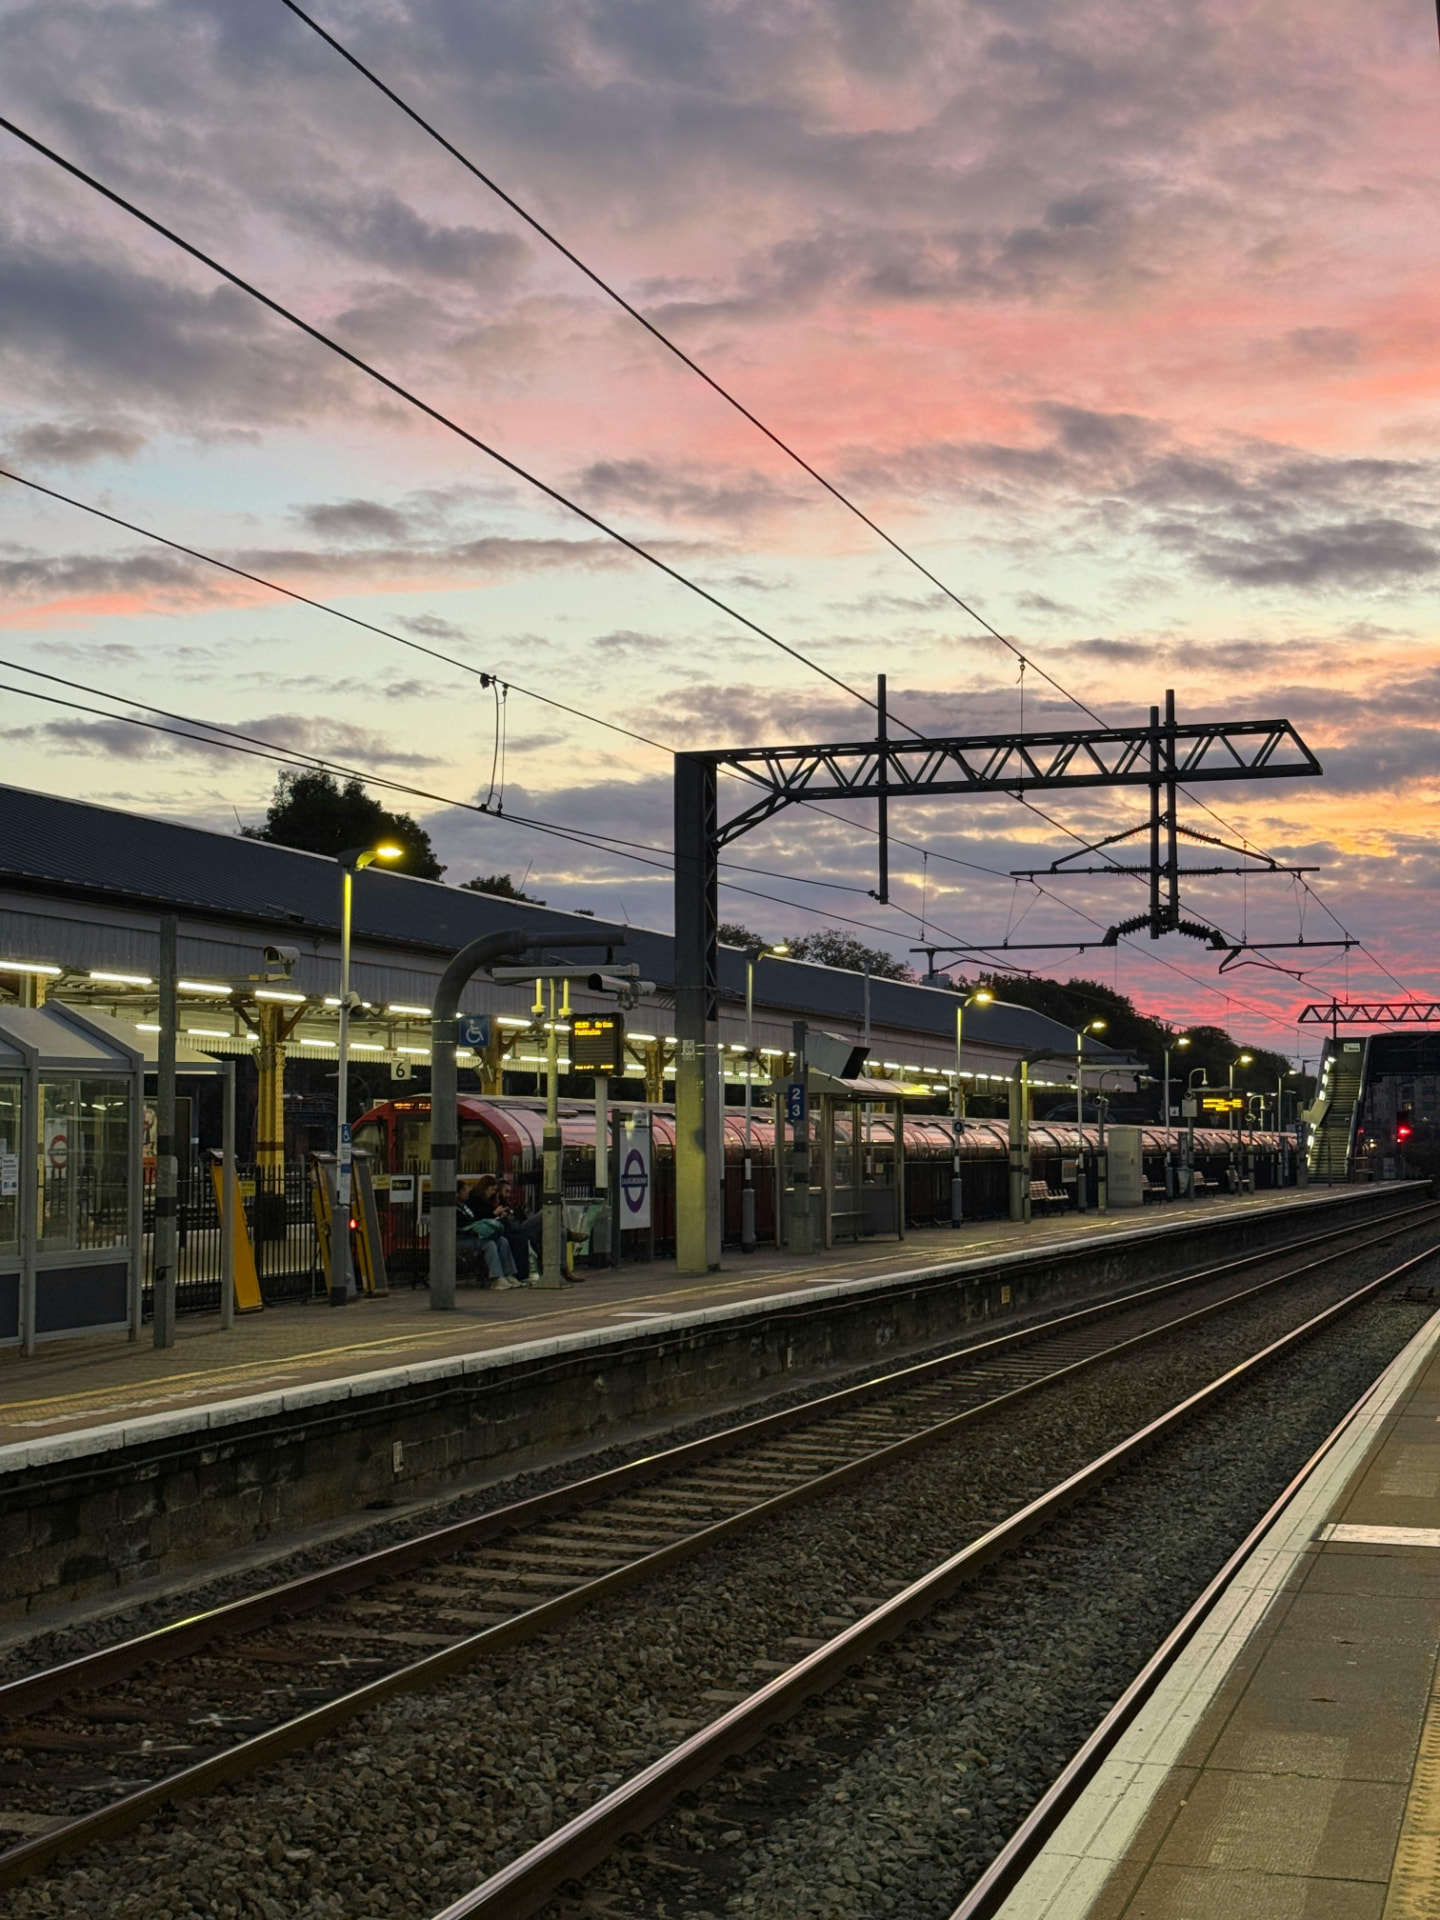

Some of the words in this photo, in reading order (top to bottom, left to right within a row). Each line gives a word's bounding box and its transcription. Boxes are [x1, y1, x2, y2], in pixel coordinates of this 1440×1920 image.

[396, 1062, 405, 1078] 6
[792, 1087, 801, 1100] 2
[792, 1104, 801, 1117] 3
[955, 1122, 962, 1132] 4
